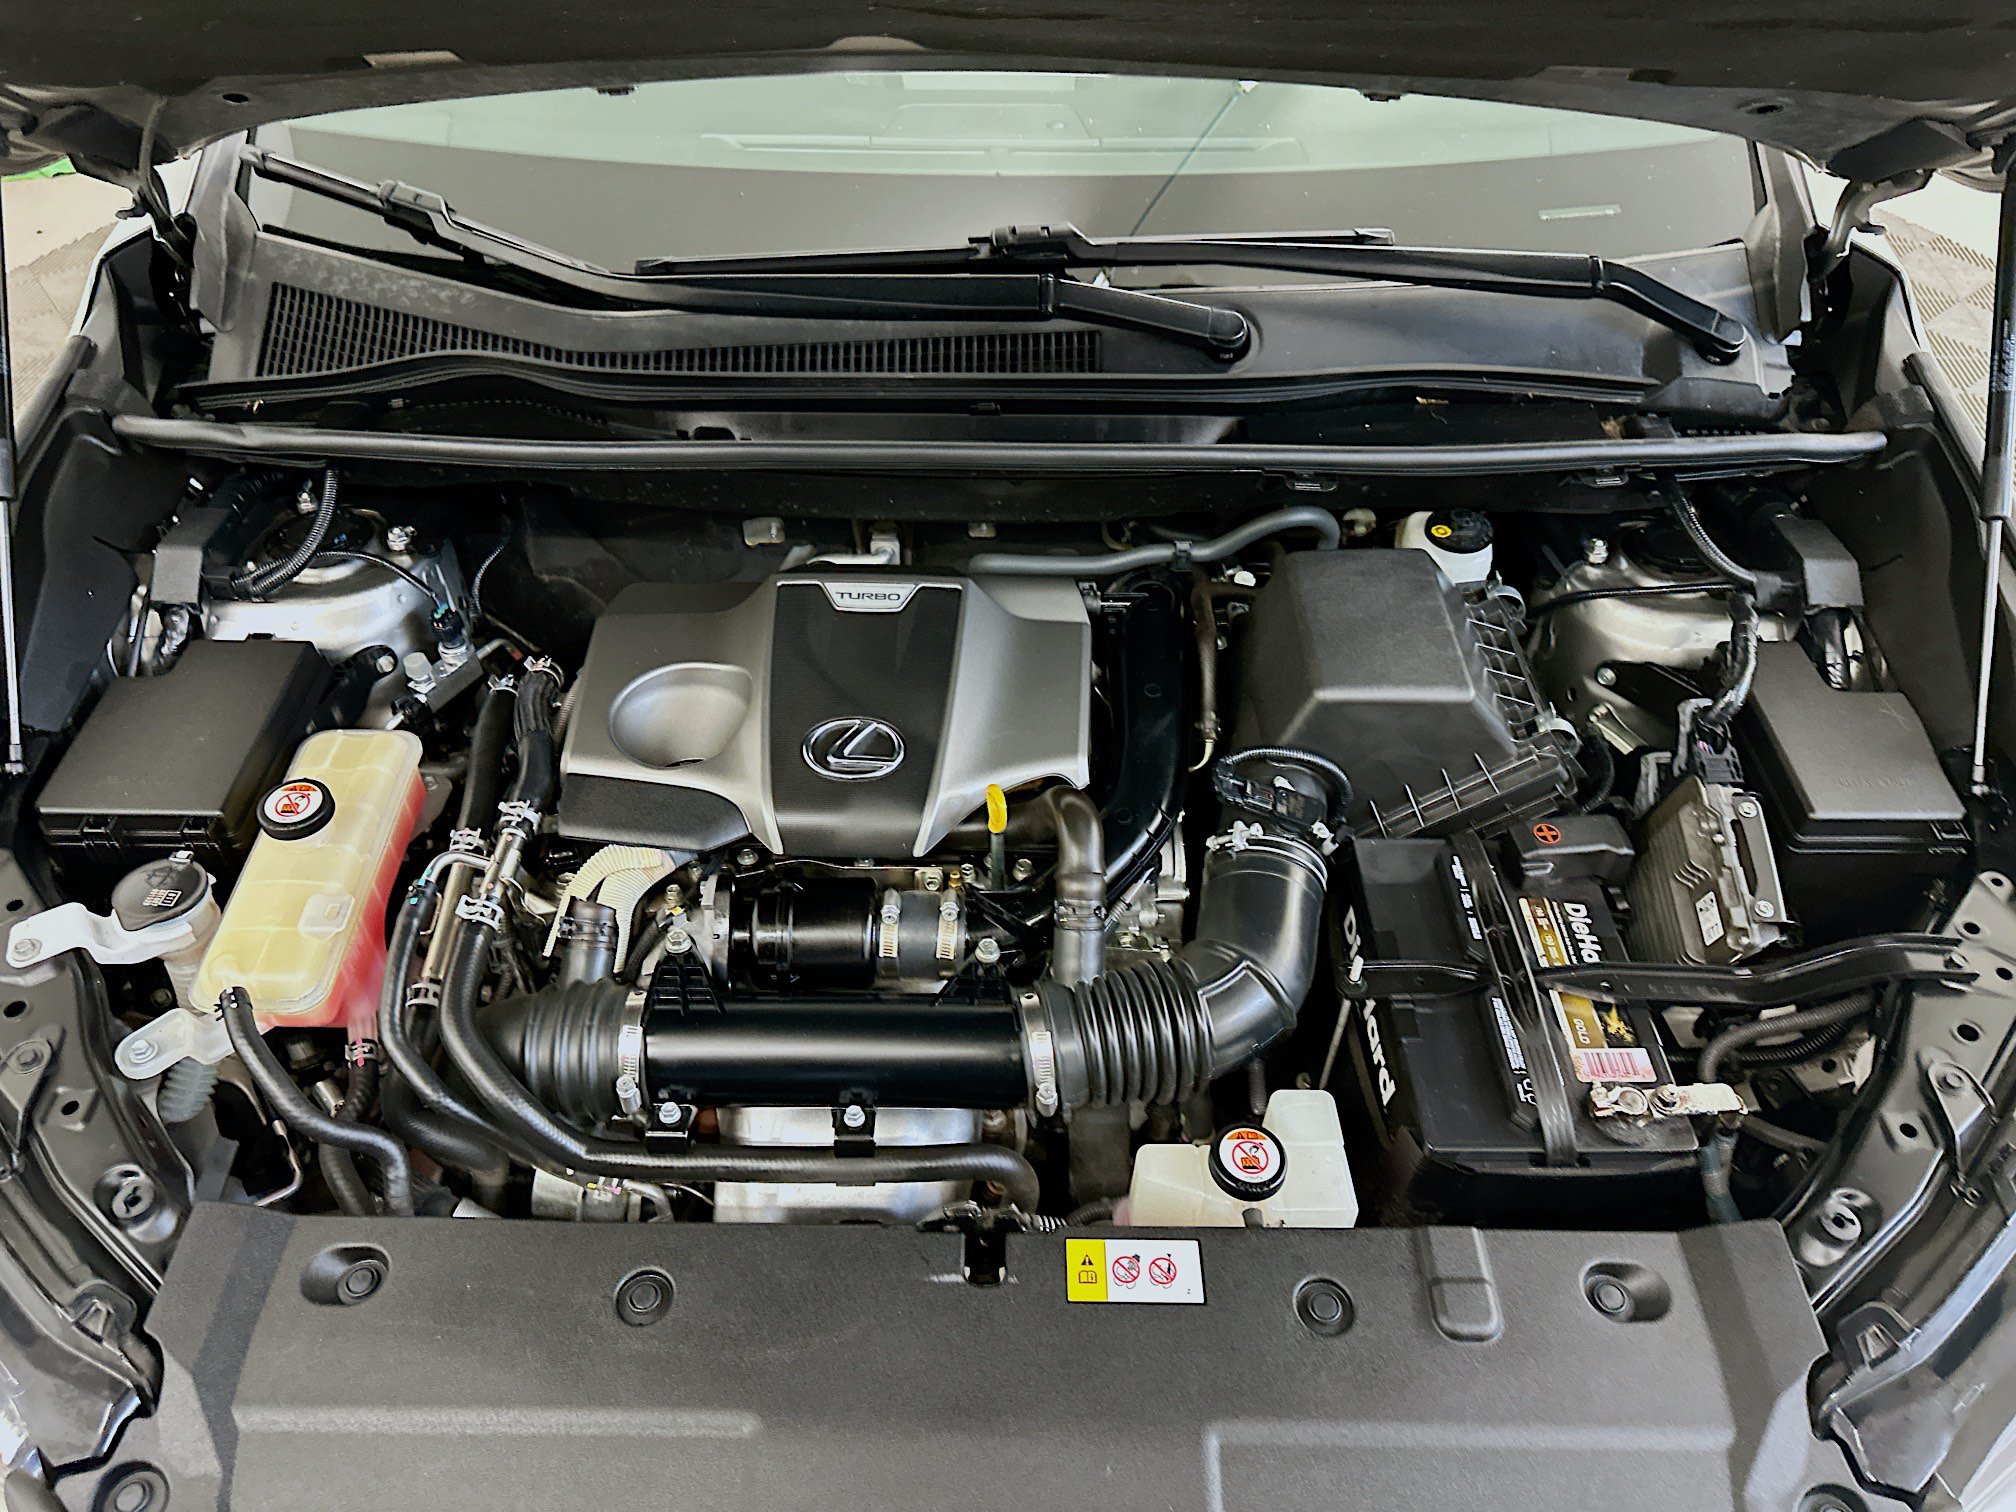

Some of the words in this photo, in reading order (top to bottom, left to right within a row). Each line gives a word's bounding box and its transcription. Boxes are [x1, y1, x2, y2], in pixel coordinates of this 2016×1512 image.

[835, 591, 901, 601] TURBO
[1563, 902, 1602, 964] DieHa
[1573, 1018, 1591, 1045] GOLD
